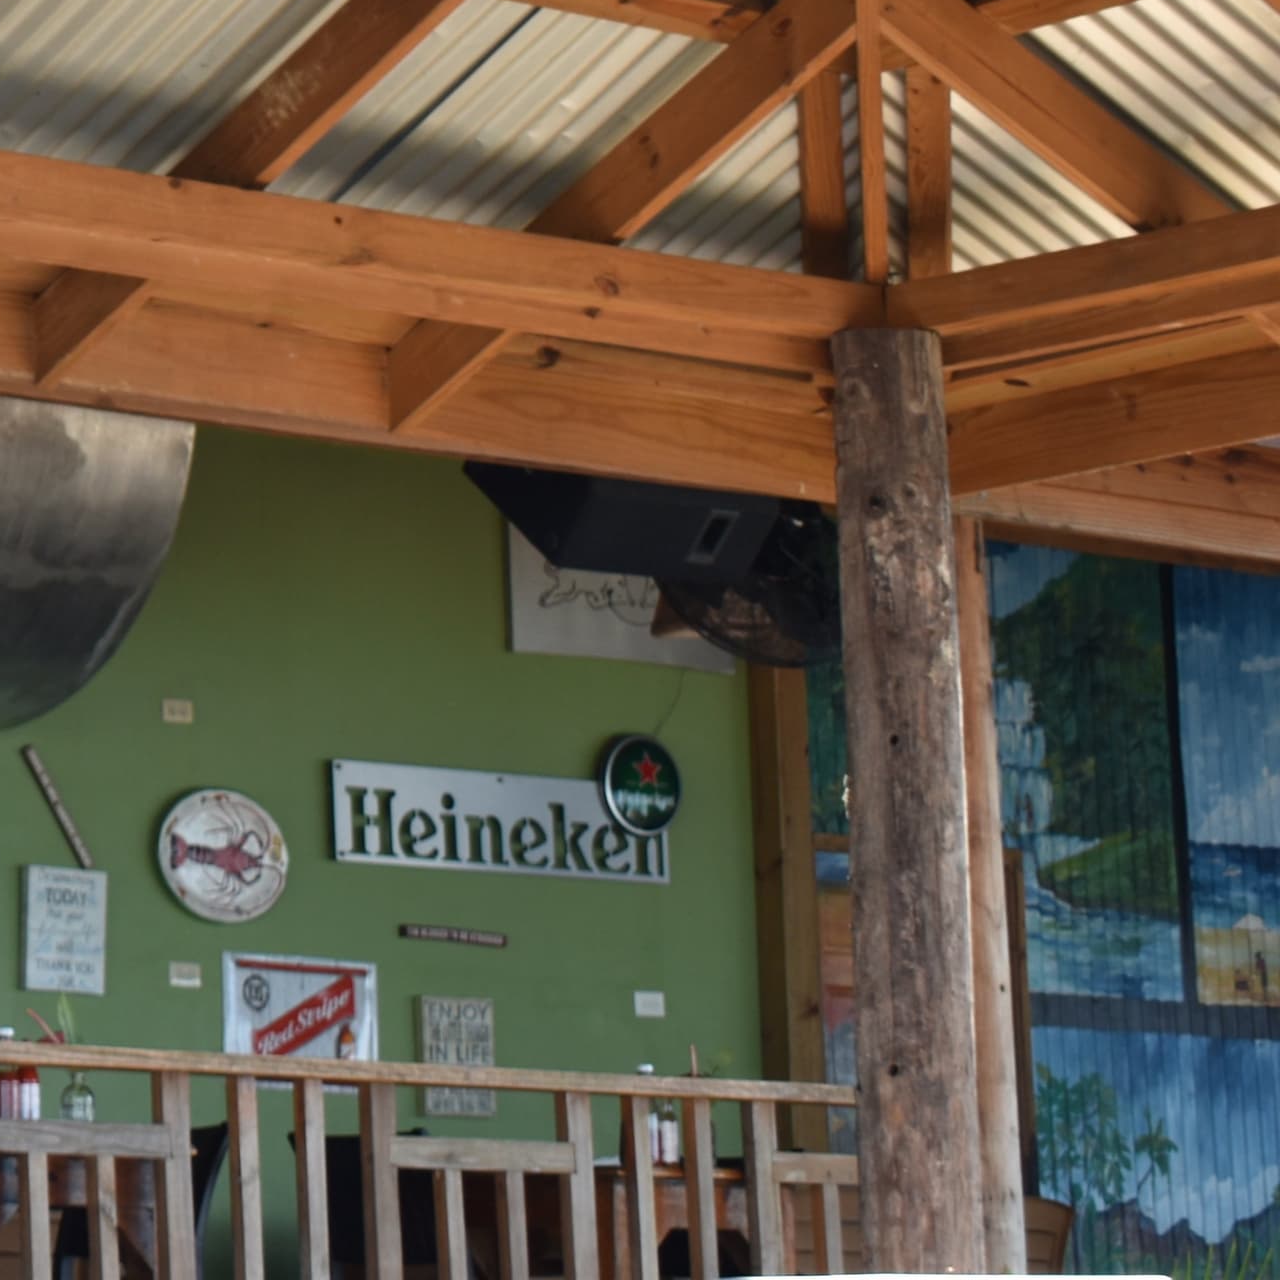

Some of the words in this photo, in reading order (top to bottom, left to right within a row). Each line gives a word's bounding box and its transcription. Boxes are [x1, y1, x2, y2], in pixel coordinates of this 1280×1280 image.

[345, 785, 665, 877] Heineken
[257, 1021, 294, 1054] Red
[294, 988, 352, 1033] Stripe
[428, 1001, 489, 1022] ENJOY
[429, 1044, 449, 1062] IN
[455, 1044, 491, 1064] LIFE
